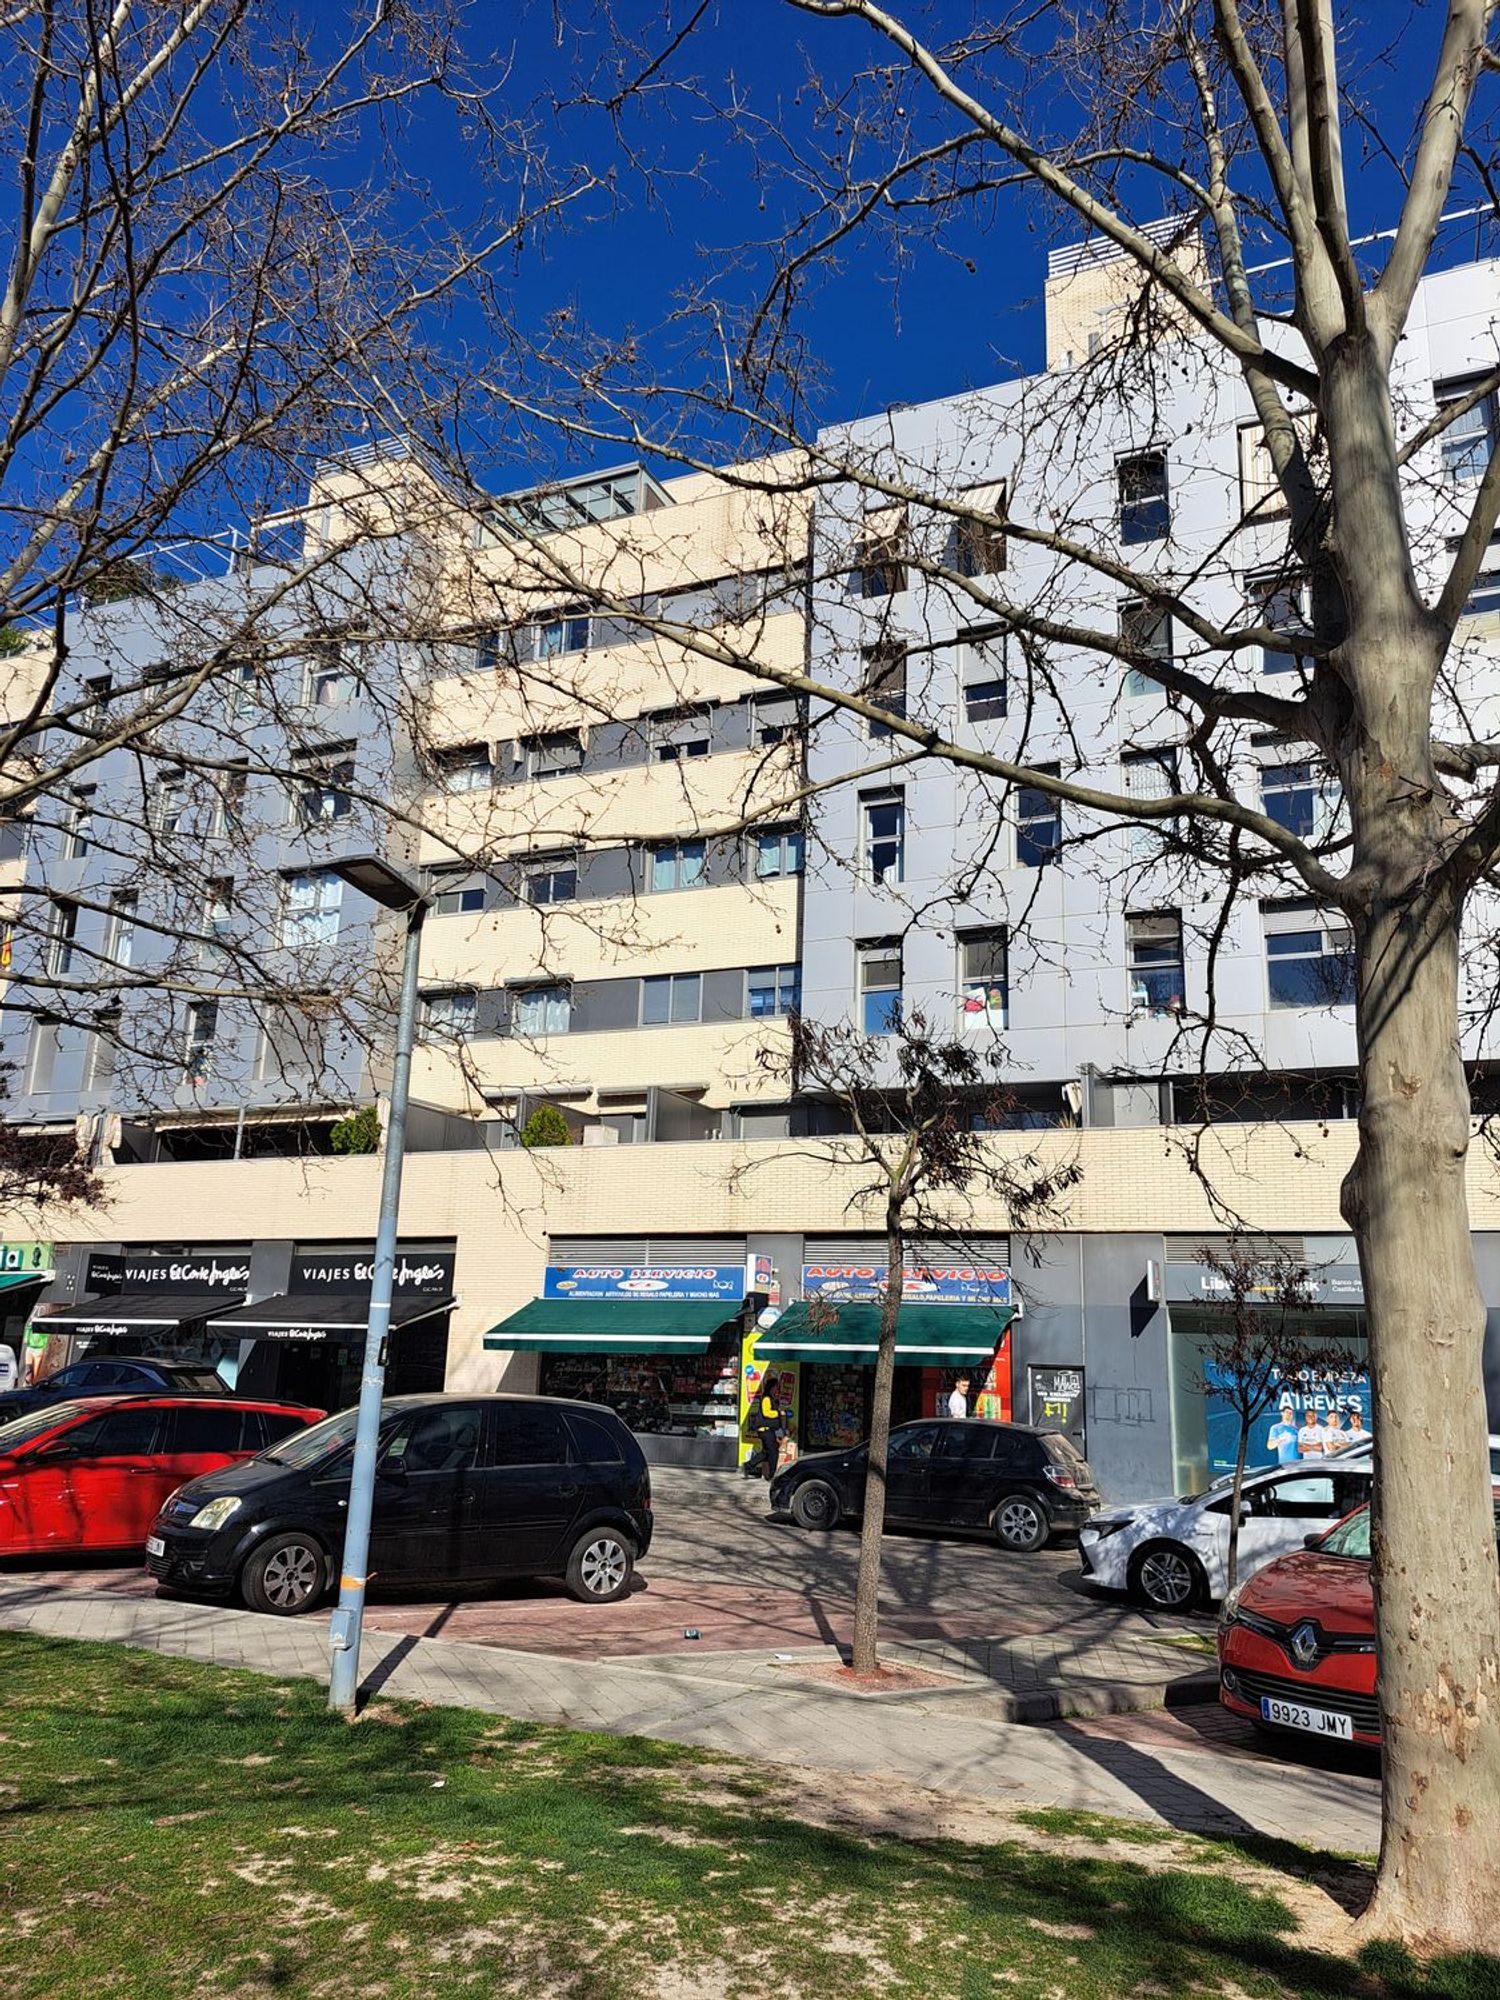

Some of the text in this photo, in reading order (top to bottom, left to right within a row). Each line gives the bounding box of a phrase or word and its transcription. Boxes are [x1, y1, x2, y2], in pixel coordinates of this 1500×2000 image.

[125, 1269, 167, 1282] VIAJES
[208, 1260, 250, 1286] Inglés
[303, 1268, 350, 1282] VIAJES
[398, 1258, 444, 1286] Inglés
[572, 1269, 717, 1279] AUTO SERVICIO
[807, 1267, 875, 1278] AUTO
[1279, 1391, 1363, 1413] ATREVES
[1272, 1703, 1346, 1735] 9923 JMY
